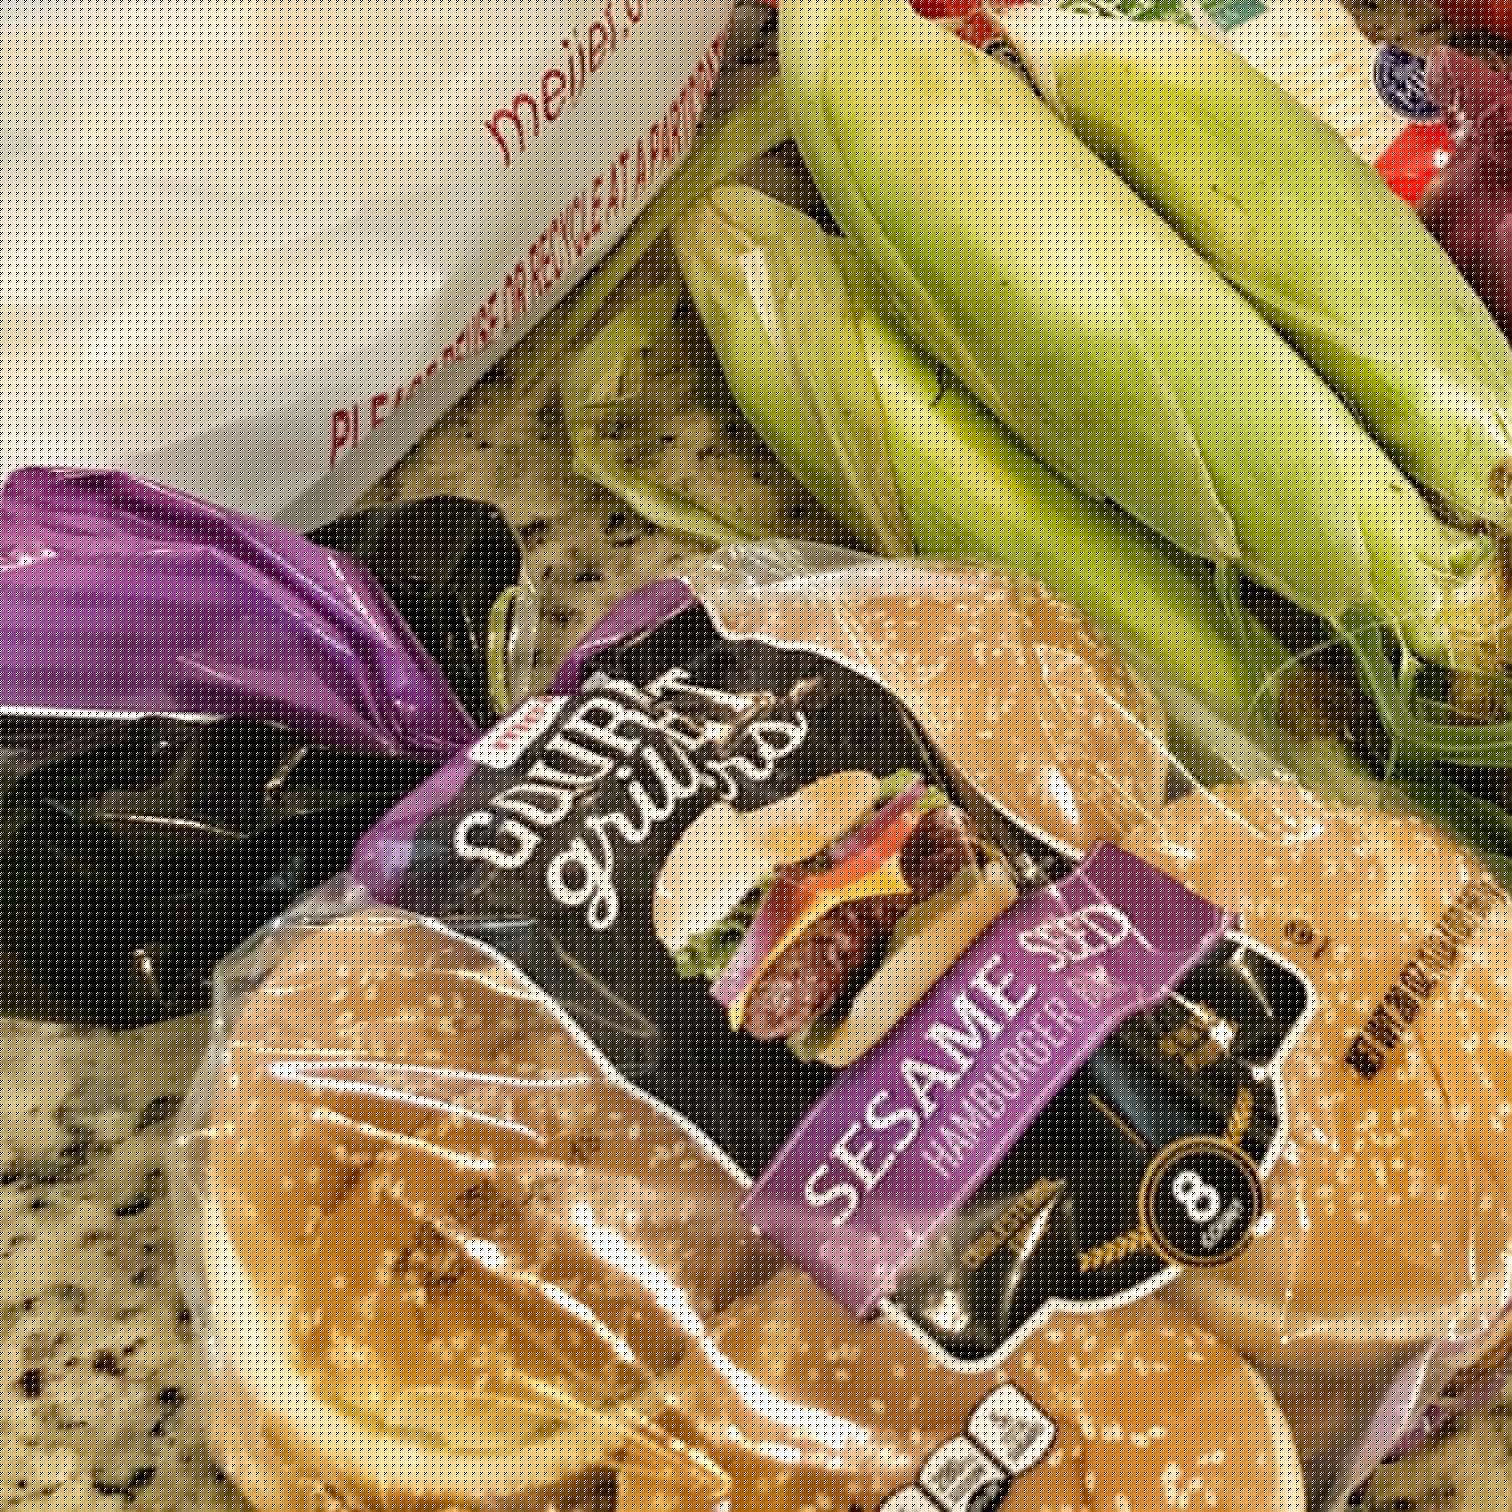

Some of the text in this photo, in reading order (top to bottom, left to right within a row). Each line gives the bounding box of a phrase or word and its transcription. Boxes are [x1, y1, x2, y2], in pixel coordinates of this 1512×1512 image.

[803, 953, 1037, 1228] SESAME
[921, 995, 1084, 1180] HAMBURGER
[1172, 1170, 1220, 1223] 8
